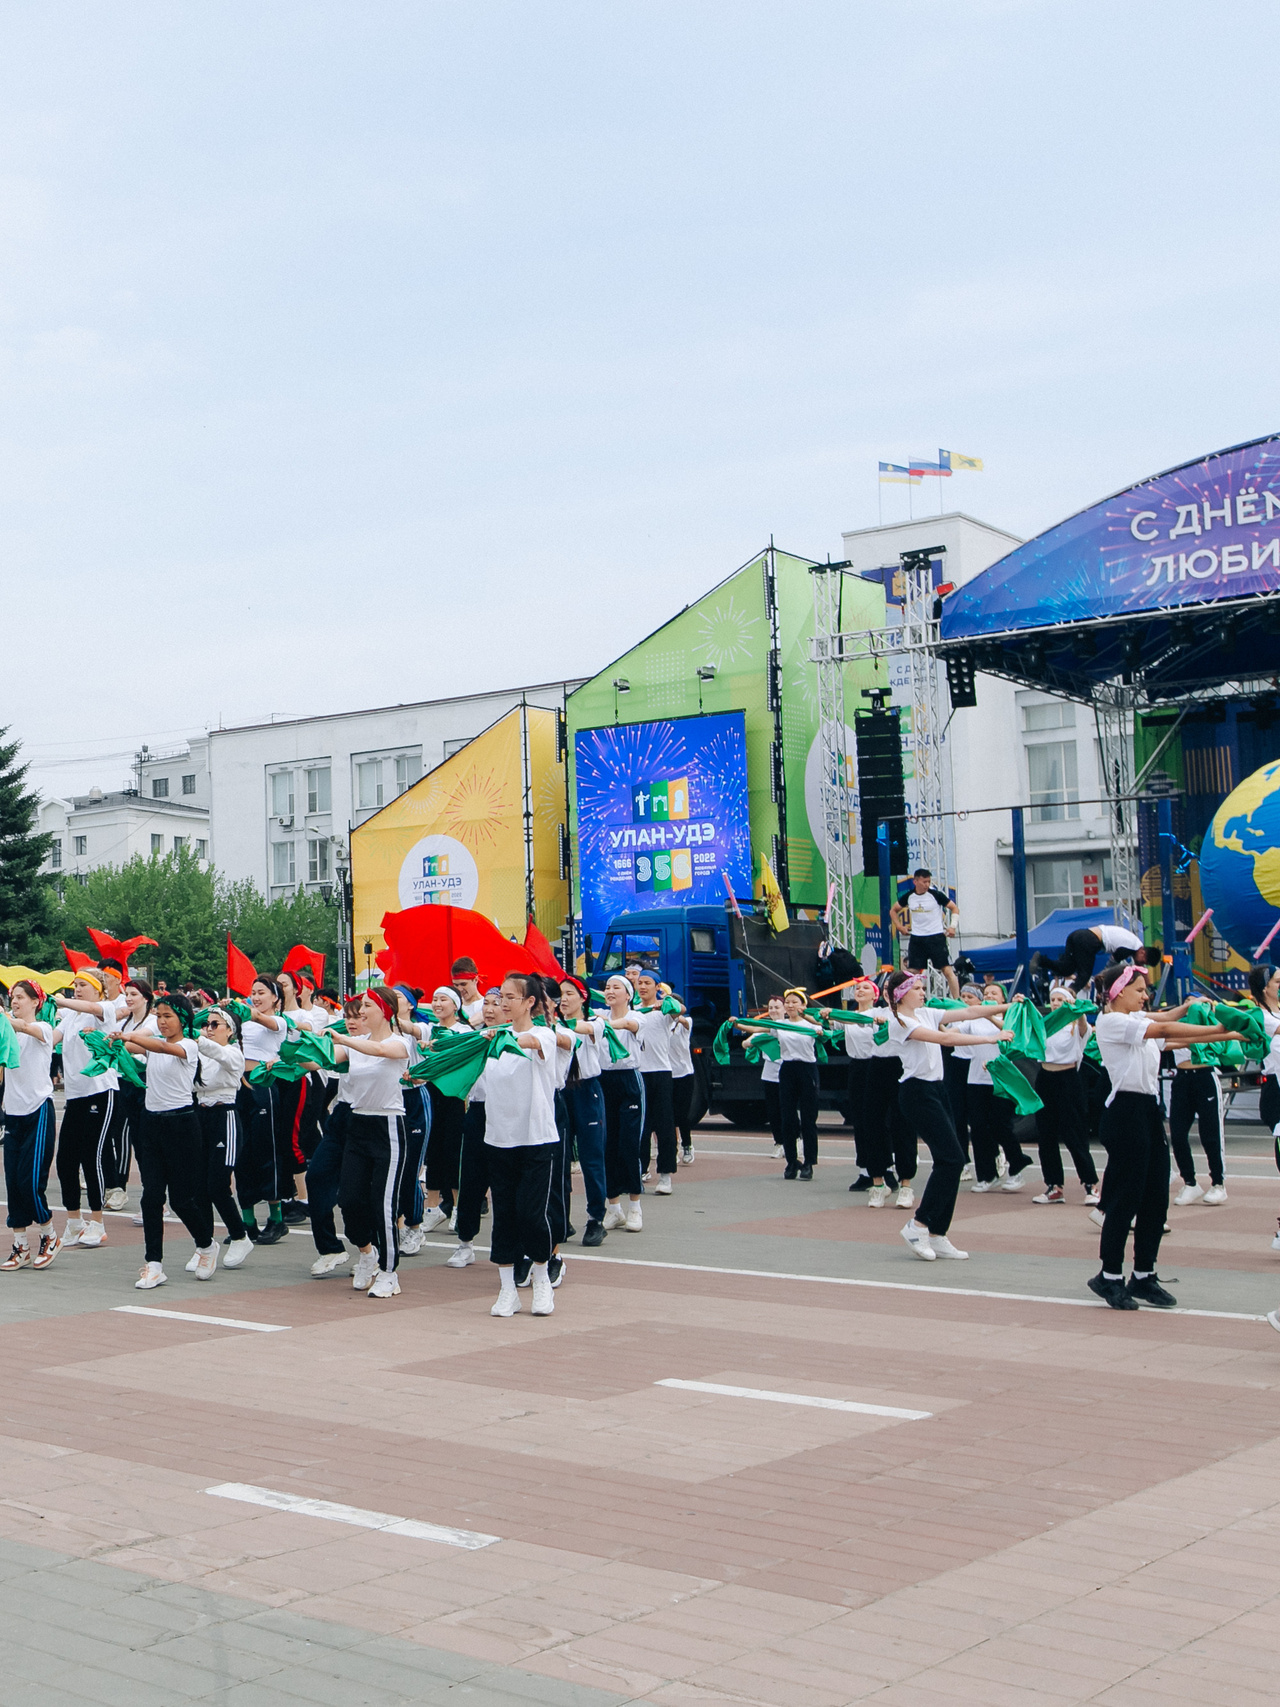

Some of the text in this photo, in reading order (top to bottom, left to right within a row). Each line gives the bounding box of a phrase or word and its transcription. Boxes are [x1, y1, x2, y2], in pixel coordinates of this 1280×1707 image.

[1130, 511, 1160, 541] С
[1146, 538, 1280, 586] ЛЮБИ
[609, 822, 715, 848] УЛАН-УДЭ
[613, 859, 632, 869] 1666
[636, 854, 691, 881] 356
[693, 853, 716, 863] 2022
[413, 877, 462, 889] УЛАН-УДЭ
